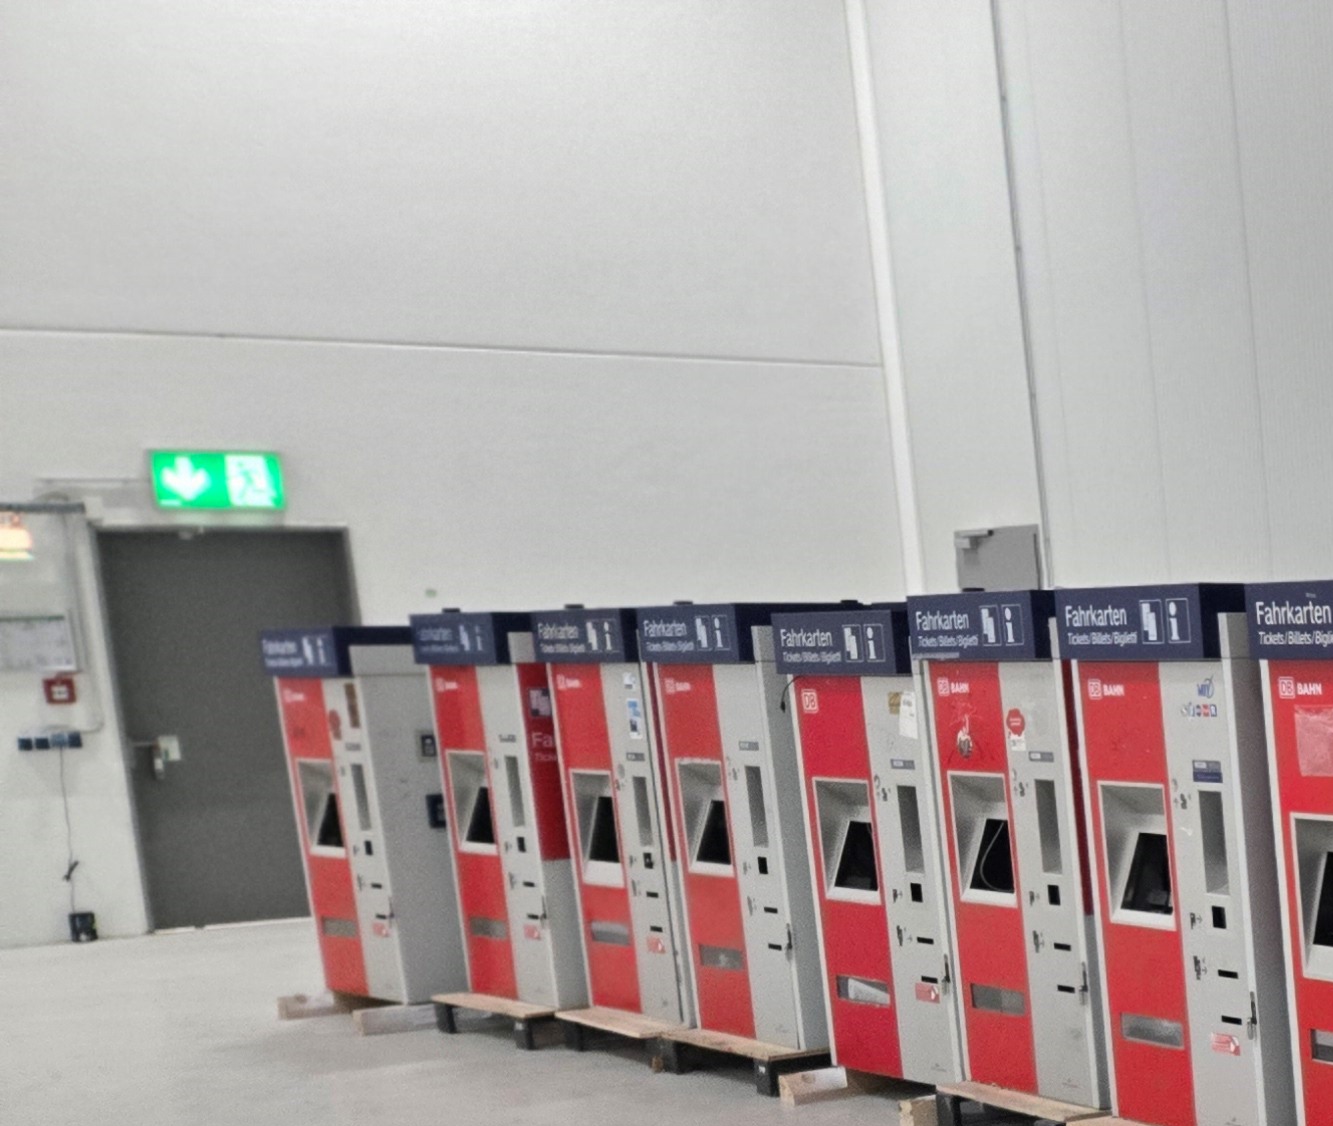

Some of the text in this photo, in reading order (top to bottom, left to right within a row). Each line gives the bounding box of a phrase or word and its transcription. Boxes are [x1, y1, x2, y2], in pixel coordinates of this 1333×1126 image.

[916, 611, 969, 631] Fahrkarten
[1065, 604, 1127, 627] Fahrkarten
[1255, 600, 1332, 626] Fahrkarten
[780, 628, 833, 648] Fahrkarten
[1103, 684, 1124, 696] BAHN
[1280, 679, 1322, 696] DB BAHN
